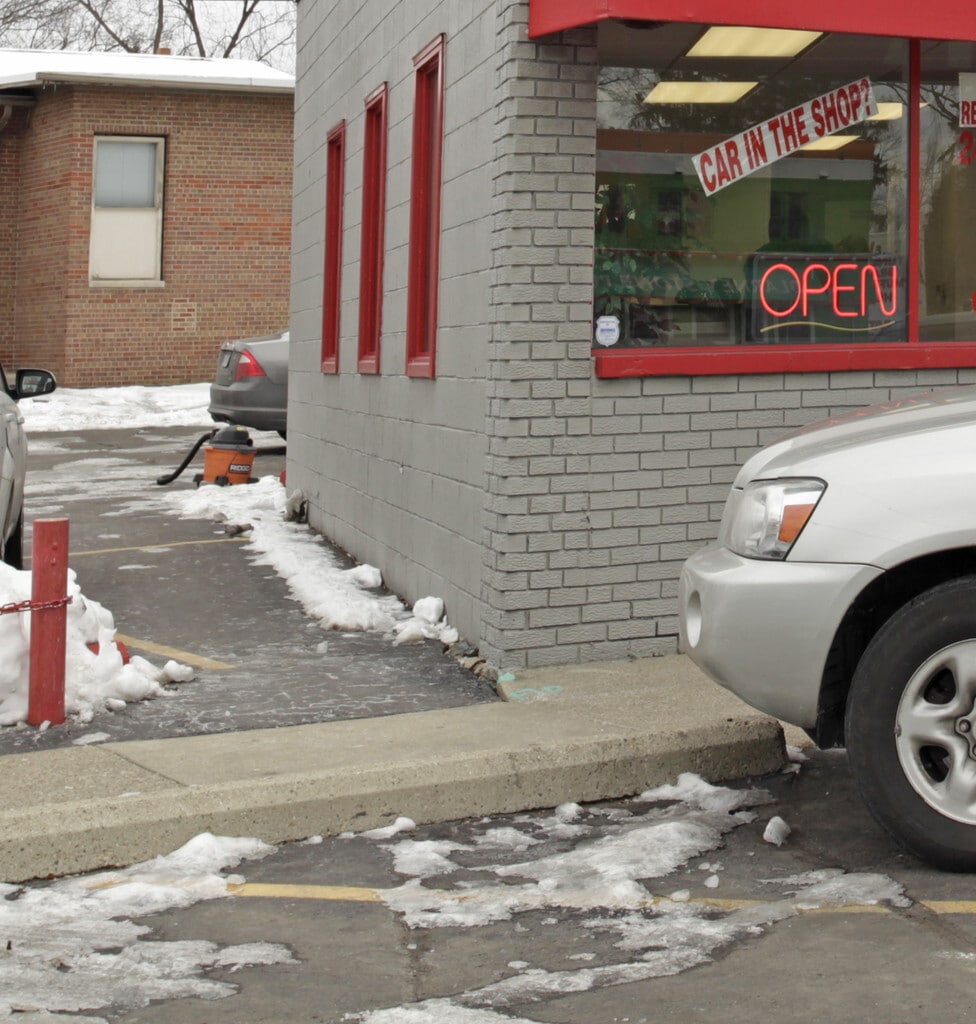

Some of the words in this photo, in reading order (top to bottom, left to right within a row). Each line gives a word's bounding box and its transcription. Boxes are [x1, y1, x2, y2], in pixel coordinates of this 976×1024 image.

[700, 140, 743, 192] CAR
[743, 126, 768, 170] IN
[768, 107, 810, 157] THE
[811, 79, 871, 137] SHOP?
[760, 263, 897, 317] OPEN
